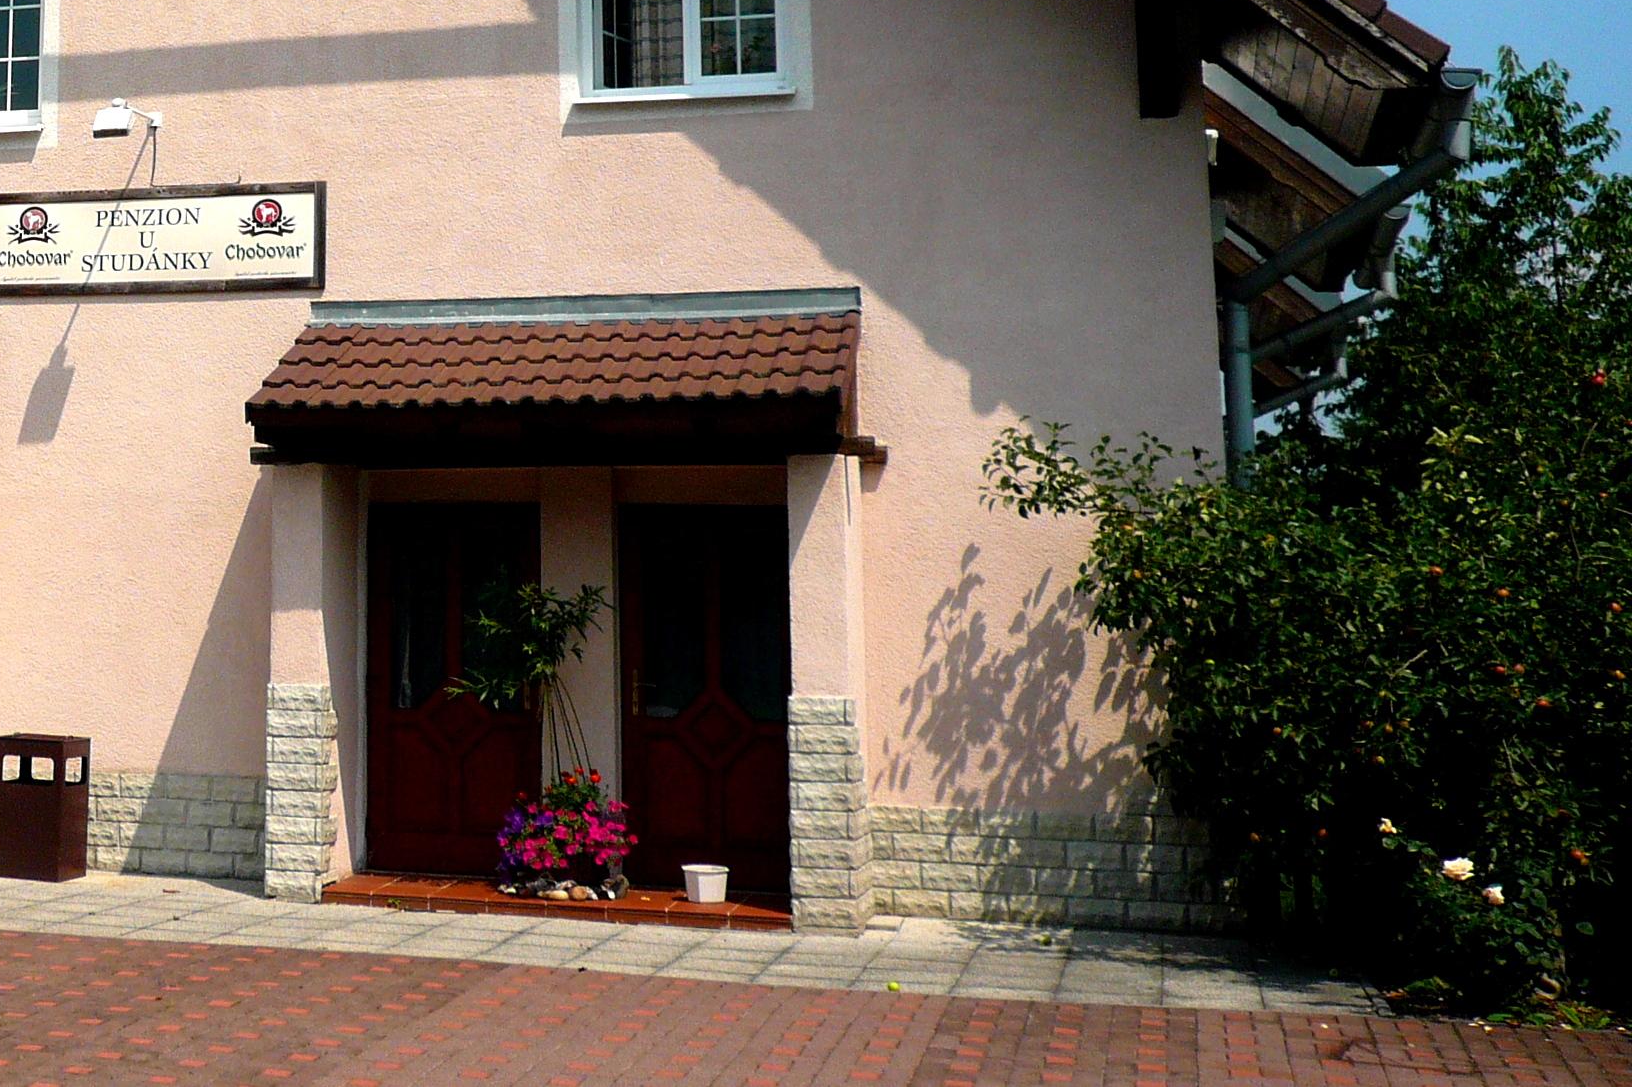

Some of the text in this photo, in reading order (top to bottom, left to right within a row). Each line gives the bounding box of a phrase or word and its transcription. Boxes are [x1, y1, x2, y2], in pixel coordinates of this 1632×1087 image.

[96, 207, 201, 227] PENZION
[138, 231, 155, 249] U
[81, 247, 213, 273] STUDÁNKY
[225, 243, 305, 262] Chodovar
